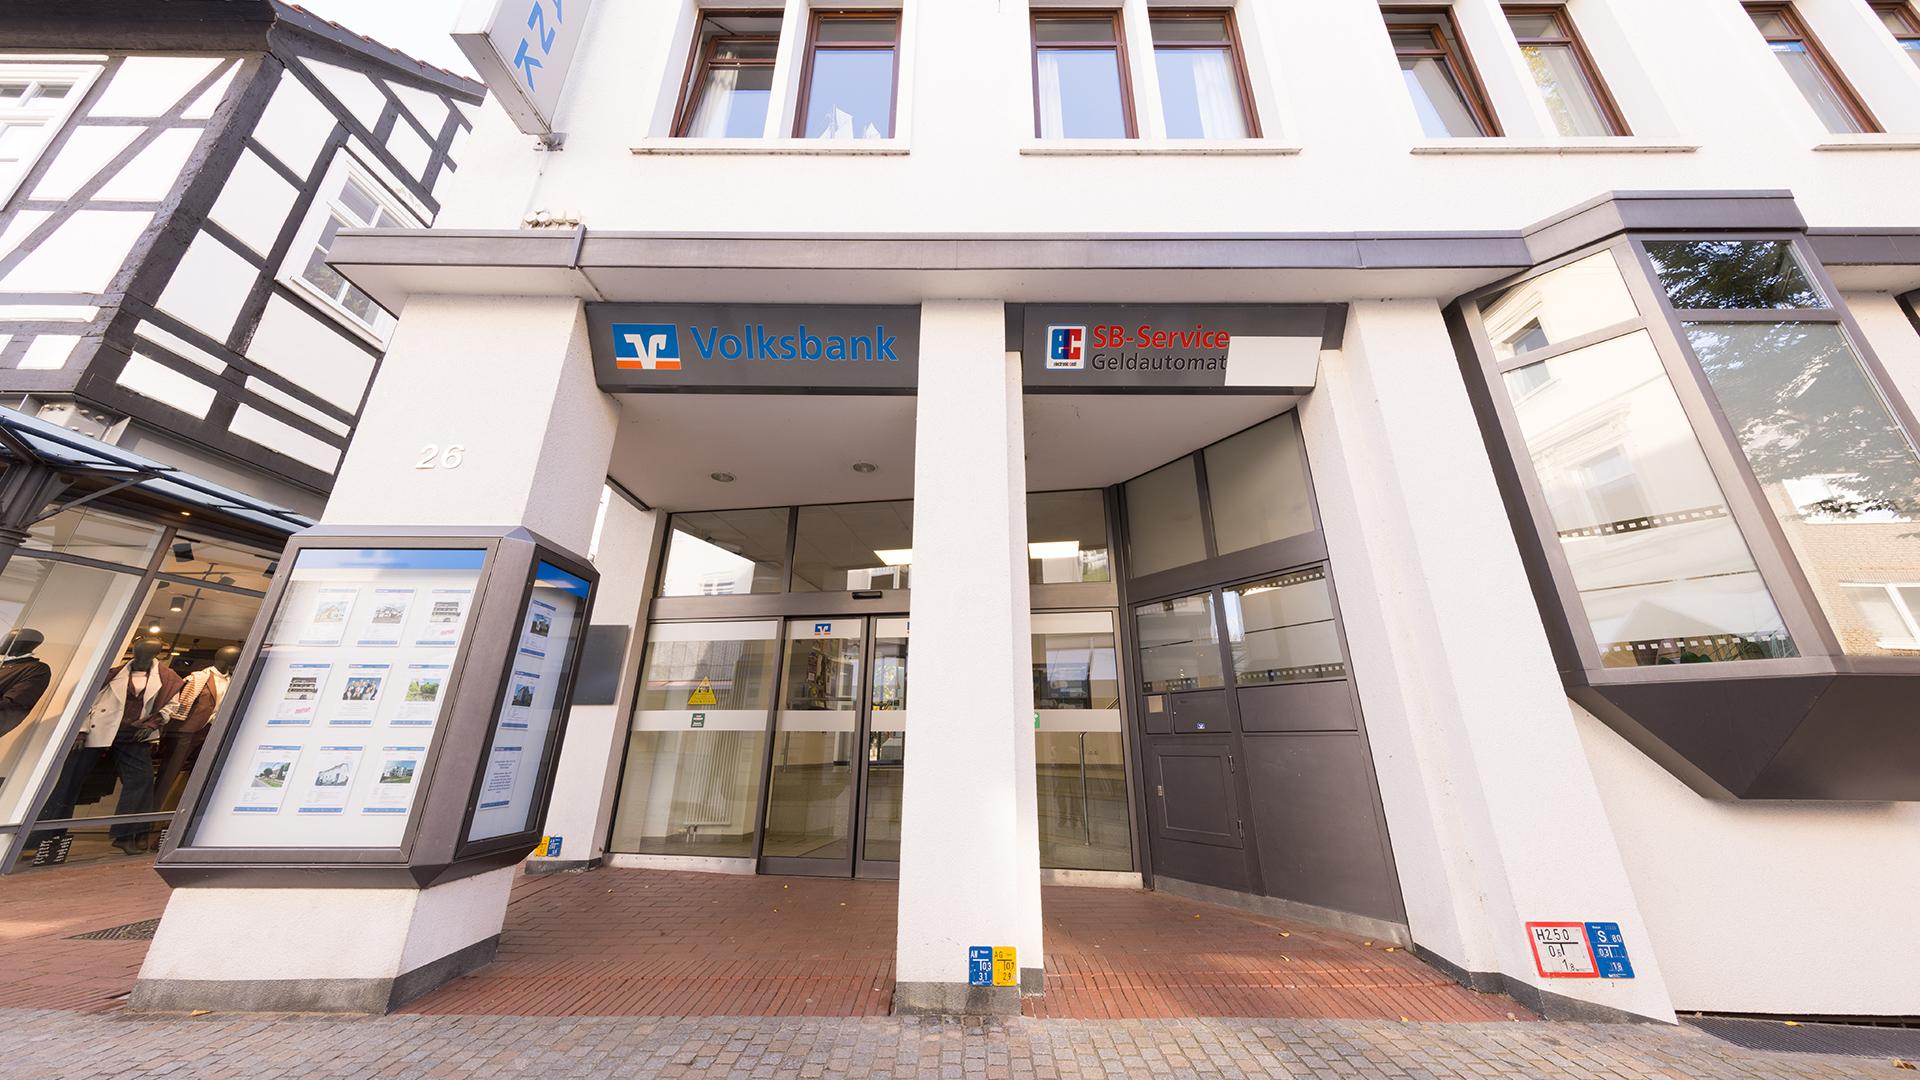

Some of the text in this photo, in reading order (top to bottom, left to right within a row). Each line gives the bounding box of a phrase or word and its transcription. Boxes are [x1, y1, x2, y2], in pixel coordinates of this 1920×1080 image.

[690, 324, 899, 362] Volksbank
[1092, 324, 1231, 350] SB-Service
[1091, 352, 1228, 371] Geldautomat
[415, 444, 465, 470] 26
[1597, 930, 1608, 943] S
